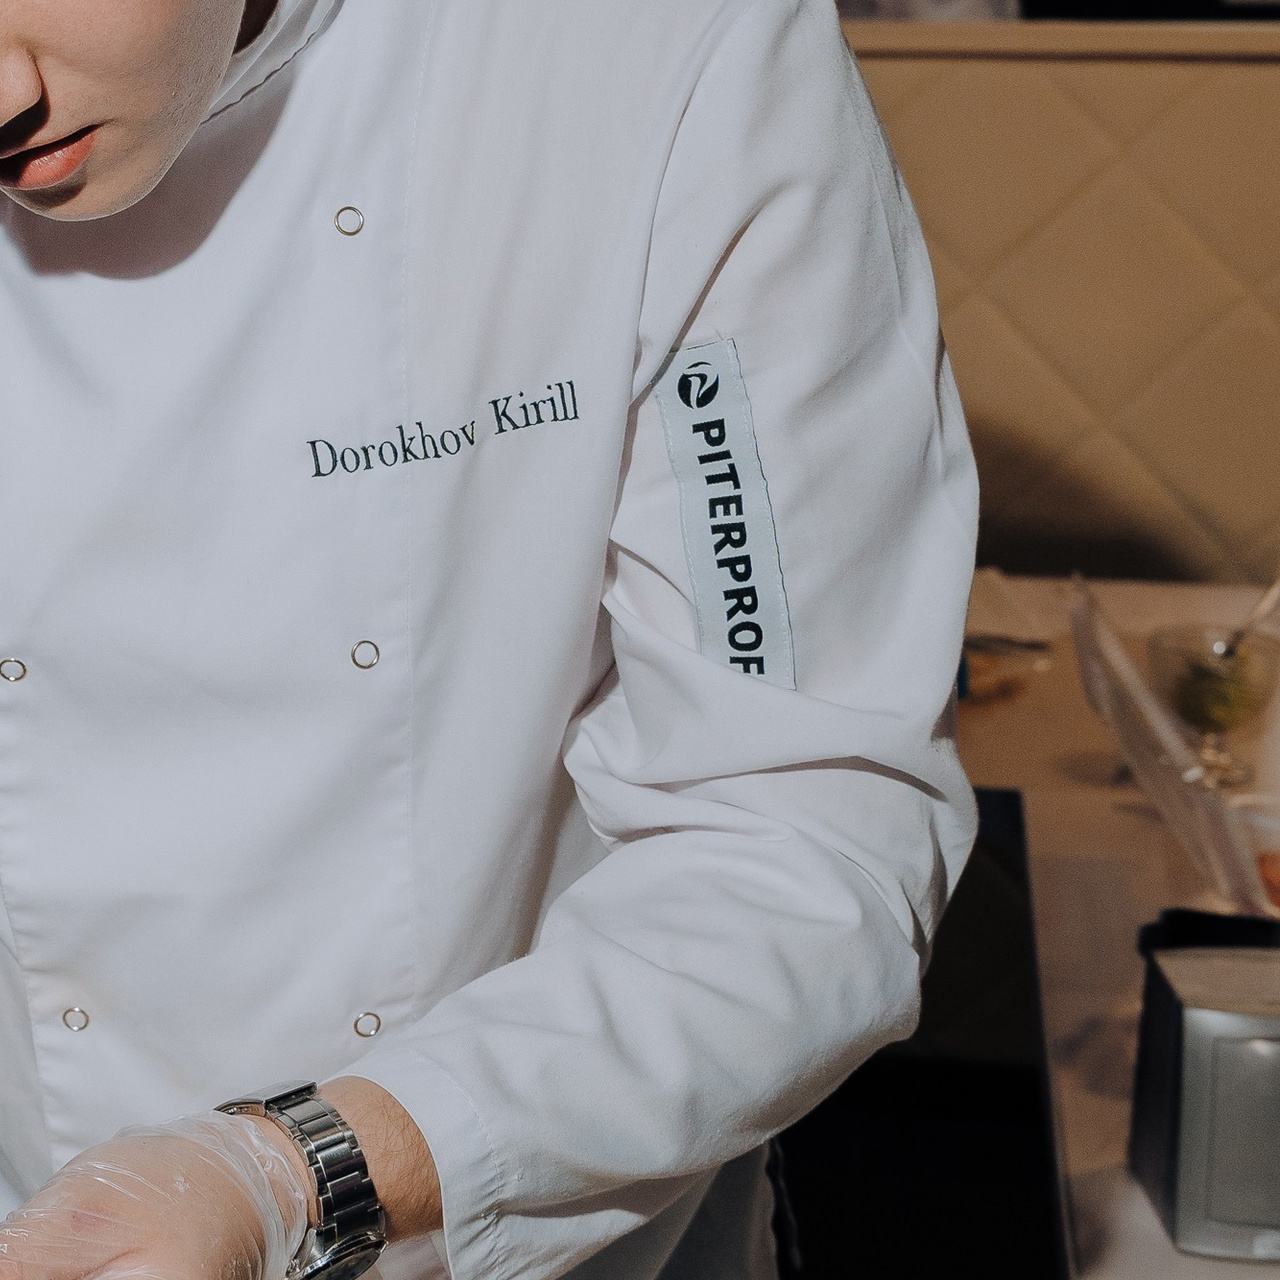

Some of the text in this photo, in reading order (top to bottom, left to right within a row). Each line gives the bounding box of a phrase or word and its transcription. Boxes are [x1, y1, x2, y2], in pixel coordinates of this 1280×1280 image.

[306, 380, 579, 477] Dorokhov Kirill
[692, 418, 765, 675] PITERPROF
